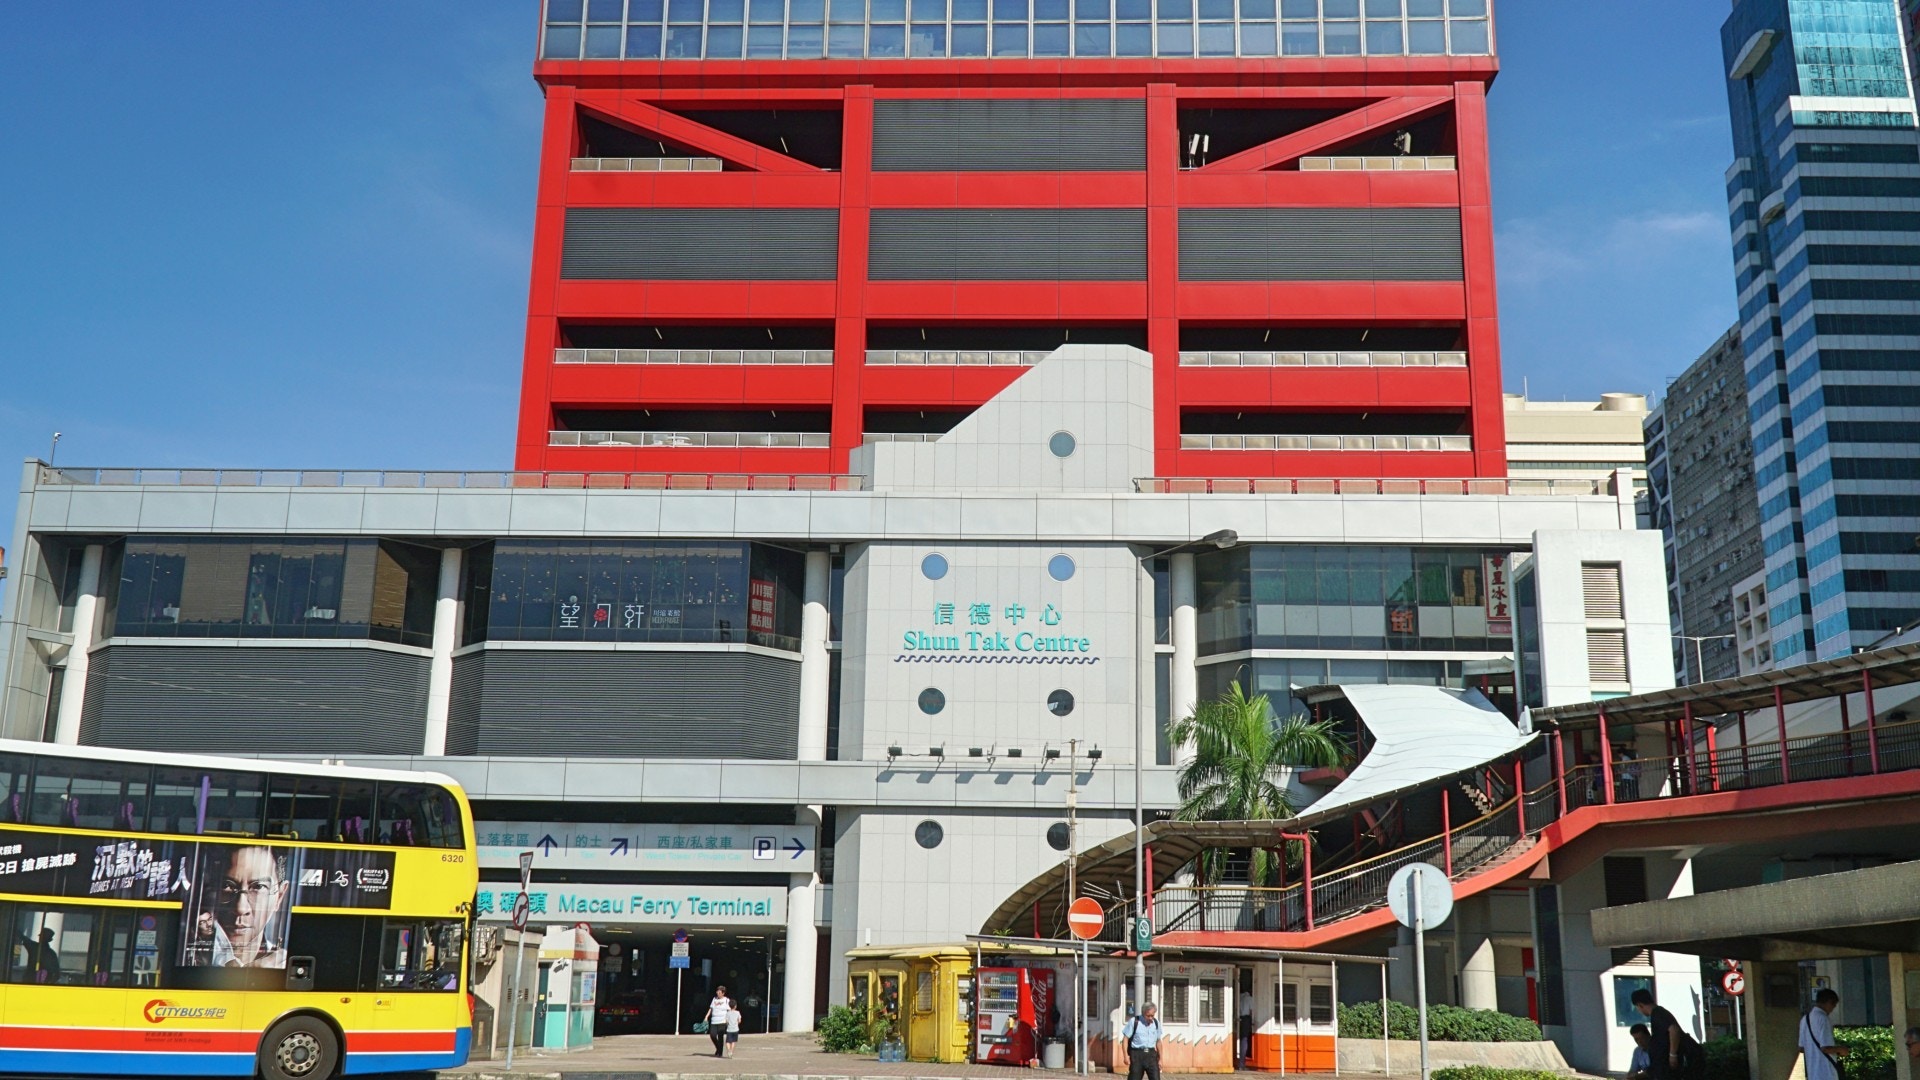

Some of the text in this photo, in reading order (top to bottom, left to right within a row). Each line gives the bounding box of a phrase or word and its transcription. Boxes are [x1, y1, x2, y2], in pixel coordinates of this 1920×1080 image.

[560, 603, 645, 628] 望月軒
[933, 601, 1062, 626] 信德中心
[903, 630, 1091, 652] Shun Tak Centre
[575, 834, 602, 848] 的士
[657, 835, 733, 850] 西座/私家車
[758, 840, 771, 857] P
[441, 854, 464, 863] 6320
[91, 841, 192, 898] 沉默的證人
[558, 894, 771, 919] Macau Ferry Terminal
[155, 1007, 227, 1018] CITYBUS 城巴
